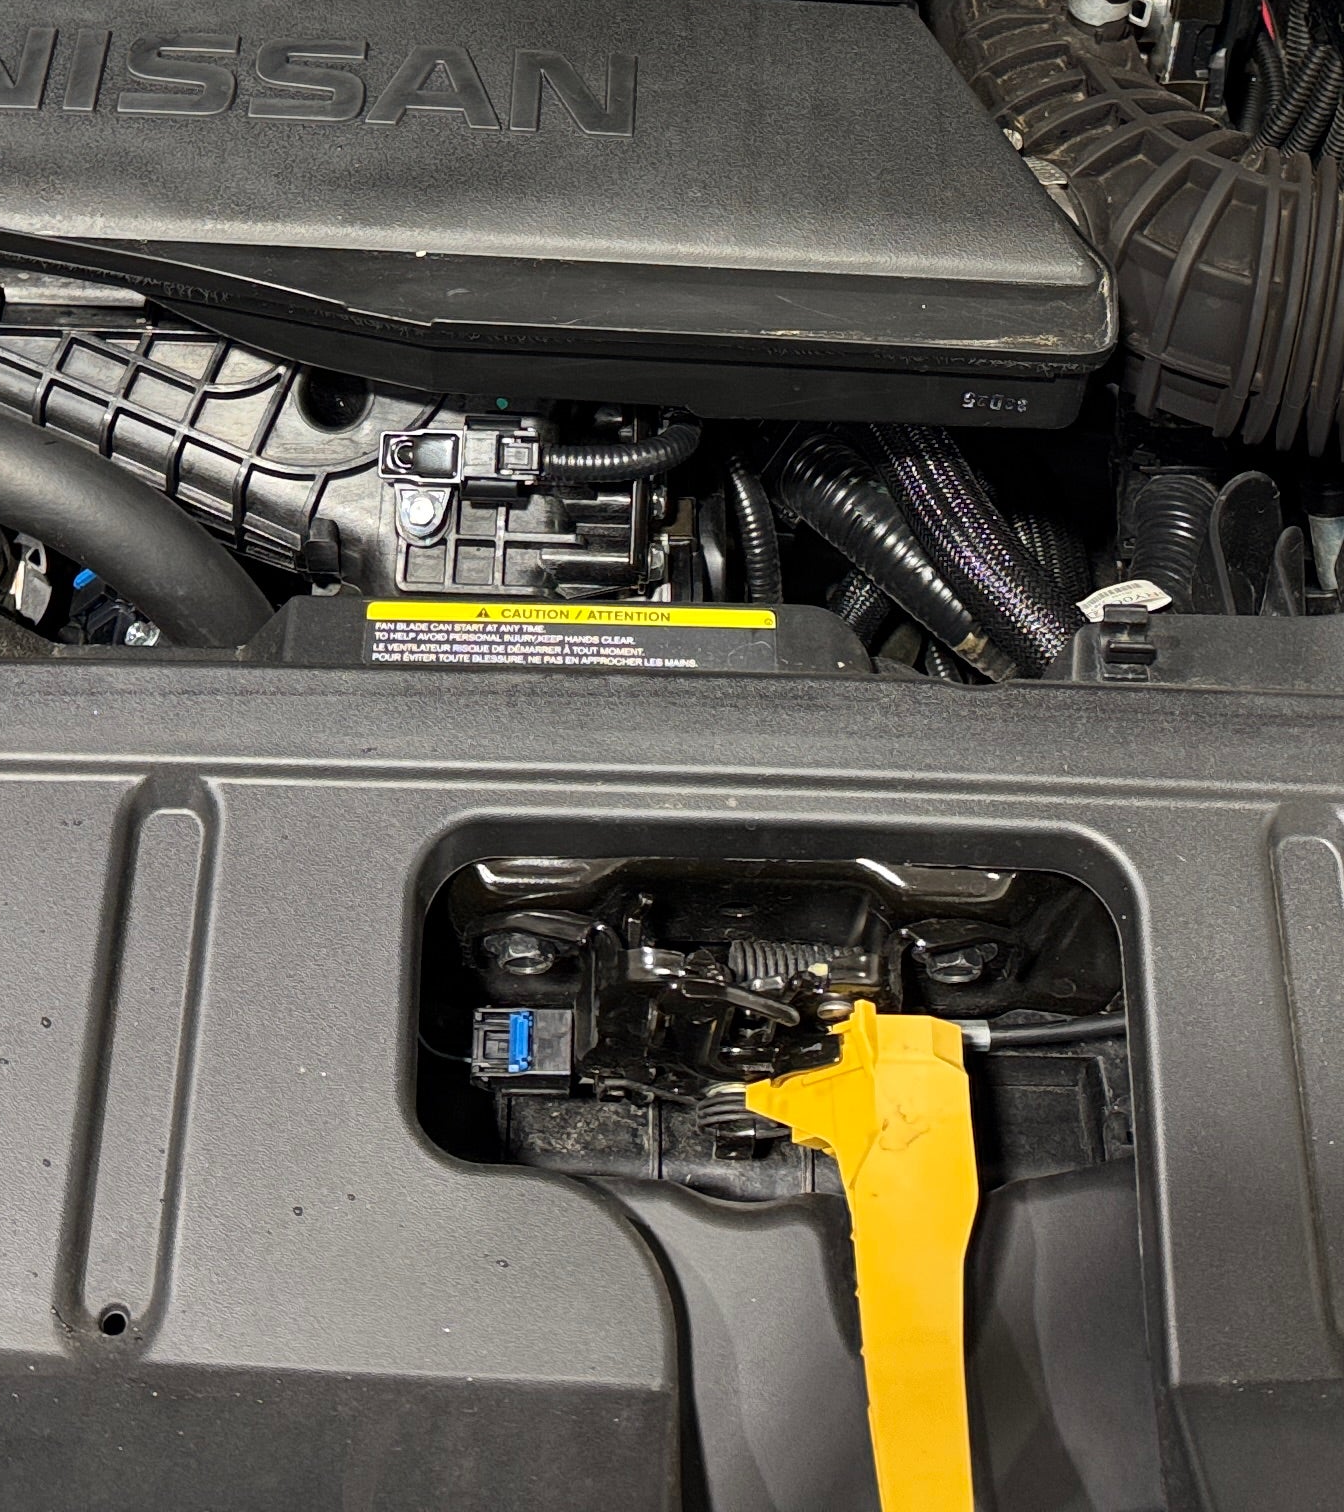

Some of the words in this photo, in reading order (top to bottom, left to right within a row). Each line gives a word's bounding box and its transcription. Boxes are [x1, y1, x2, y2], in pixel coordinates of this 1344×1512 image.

[501, 608, 570, 620] CAUTION
[587, 610, 671, 622] ATTENTION
[375, 622, 395, 631] FAN
[396, 623, 428, 631] BLADE
[430, 623, 451, 632] CAN
[453, 624, 484, 632] START
[485, 624, 498, 632] AT
[499, 624, 520, 632] ANY
[522, 624, 546, 633] TIME.
[374, 632, 388, 641] TO
[390, 632, 416, 641] HELP
[417, 633, 447, 641] AVOID
[449, 633, 502, 642] PERSONAL
[565, 635, 600, 644] HANDS
[601, 635, 636, 645] CLEAR.
[373, 642, 385, 652] LE
[387, 643, 451, 652] VENTILATEUR
[452, 644, 490, 653] RISQUE
[491, 644, 505, 653] DE
[507, 643, 561, 655] DÉMARRER
[573, 647, 598, 655] TOUT
[600, 647, 645, 656] MOMENT.
[372, 653, 401, 662] POUR
[403, 651, 436, 663] ÉVITER
[438, 654, 470, 663] TOUTE
[471, 654, 526, 665] BLESSURE,
[528, 655, 542, 664] NE
[543, 656, 563, 665] PAS
[565, 656, 580, 665] EN
[580, 657, 643, 666] APPROCHER
[644, 658, 663, 667] LES
[664, 659, 698, 668] MAINS.
